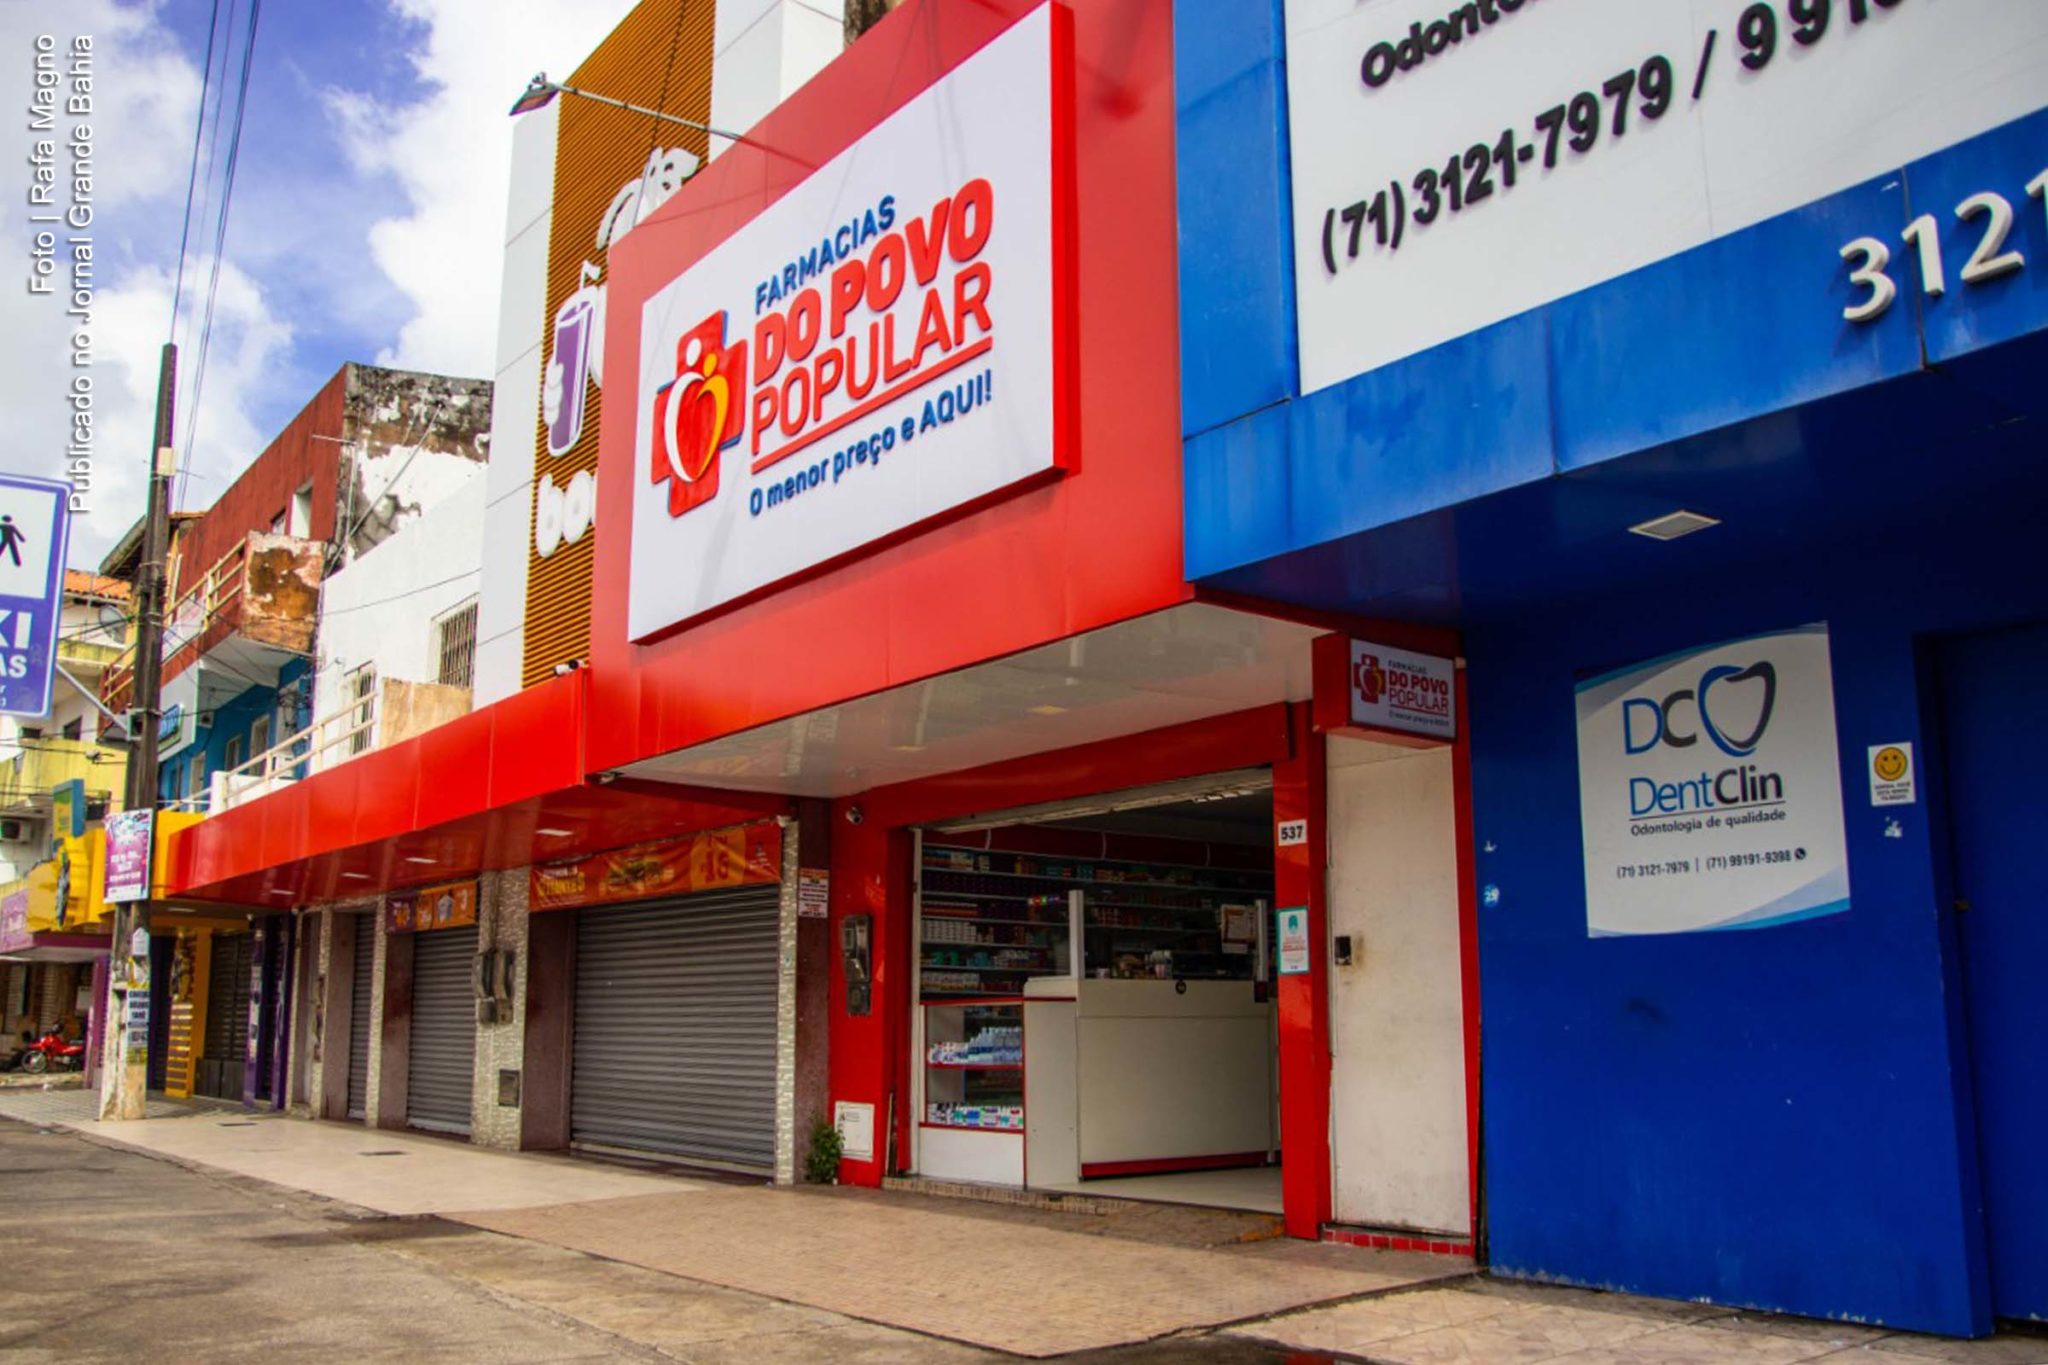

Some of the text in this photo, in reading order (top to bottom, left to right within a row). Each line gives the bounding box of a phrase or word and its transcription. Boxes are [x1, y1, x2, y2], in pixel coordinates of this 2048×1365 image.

[755, 195, 897, 315] FARMACIAS
[754, 178, 994, 387] DO POVO
[751, 261, 993, 455] POPULAR
[749, 369, 993, 517] O menor preço e AQUI!
[1389, 670, 1448, 696] DO POVO
[1389, 687, 1449, 712] POPULAR
[1629, 765, 1783, 816] DentClin
[1280, 825, 1304, 840] 537
[1630, 808, 1786, 837] Odontologia de qualidade
[1706, 855, 1728, 870] (71)
